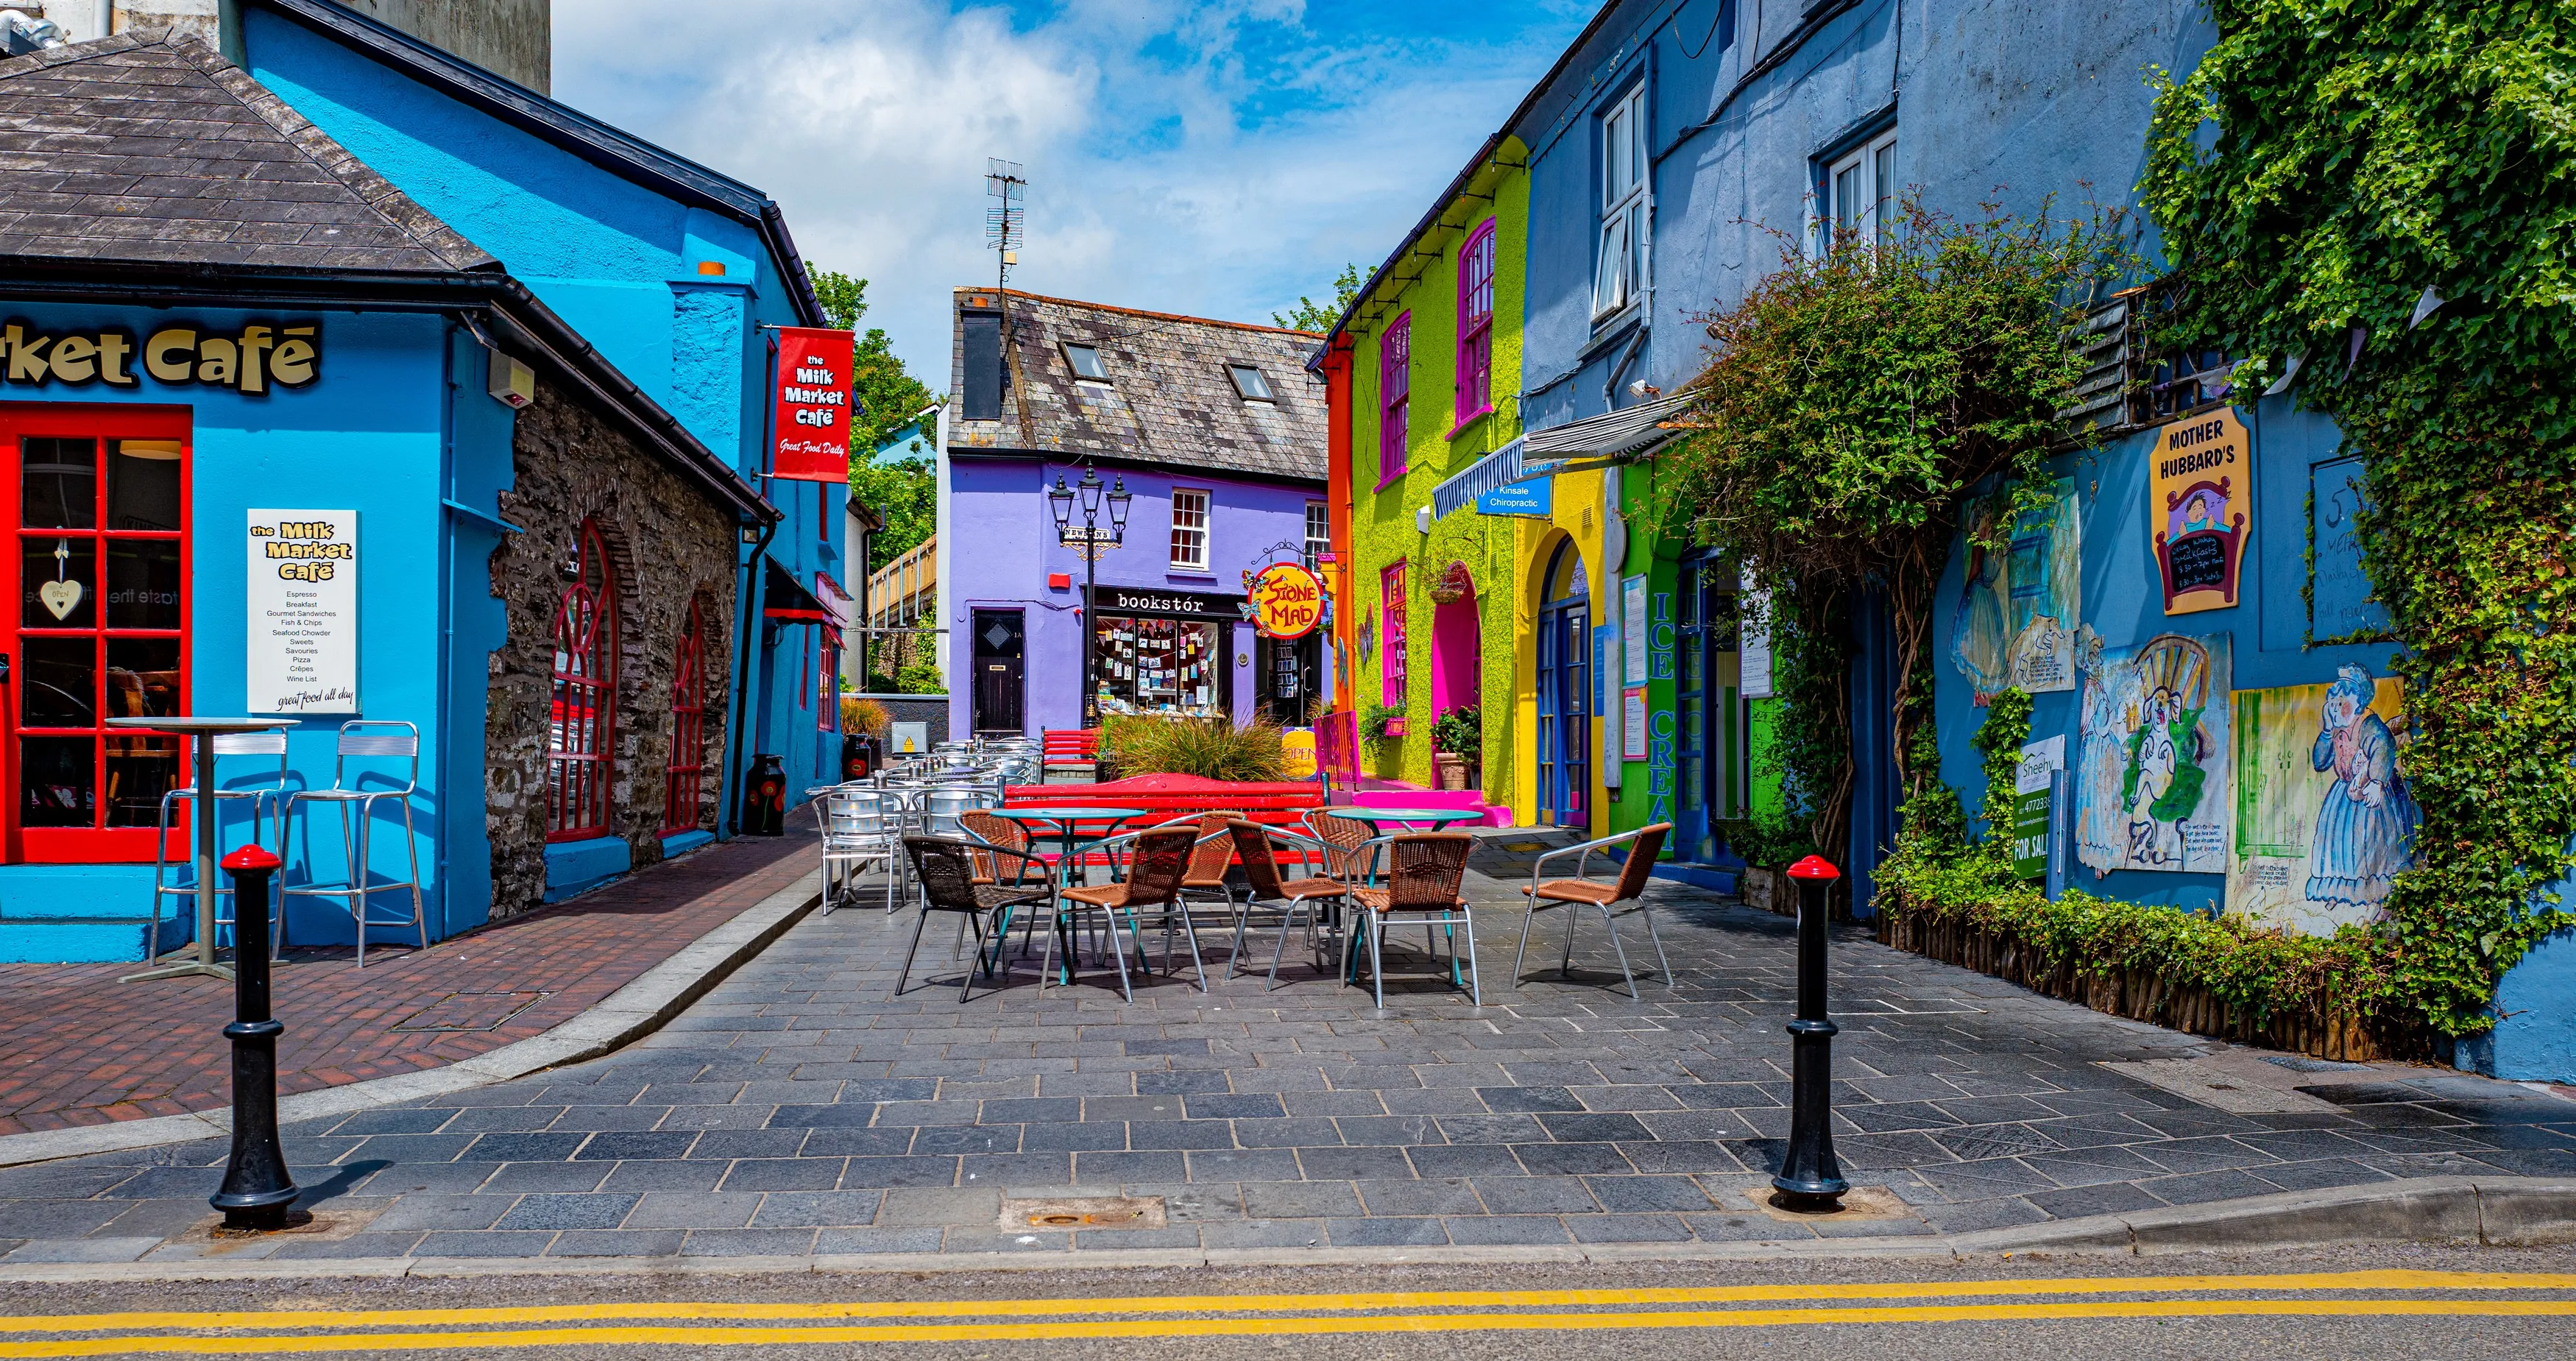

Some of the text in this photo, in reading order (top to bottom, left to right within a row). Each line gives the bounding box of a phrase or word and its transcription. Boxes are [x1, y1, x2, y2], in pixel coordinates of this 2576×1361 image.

[0, 324, 316, 392] ket Café
[807, 356, 824, 365] the
[796, 368, 834, 386] Milk
[785, 386, 845, 406] Market
[795, 409, 834, 428] Café
[2169, 420, 2223, 451] MOTHER
[780, 438, 845, 457] Great Food Daily
[2160, 445, 2234, 479] HUBBARD'S
[1499, 487, 1529, 495] Kinsale
[1490, 498, 1538, 508] Chiropractic
[251, 521, 334, 540] the Milk
[266, 542, 353, 559] Market
[278, 562, 334, 582] Café
[1264, 574, 1317, 609] STONE
[1117, 593, 1204, 612] bookstór
[303, 619, 322, 627] Chips
[1270, 604, 1314, 627] MAD
[1649, 593, 1675, 679] ICE
[290, 665, 314, 674] Crêpes
[275, 687, 353, 711] great food all day
[2023, 758, 2053, 777] Sheehy
[2014, 838, 2029, 861] FOR
